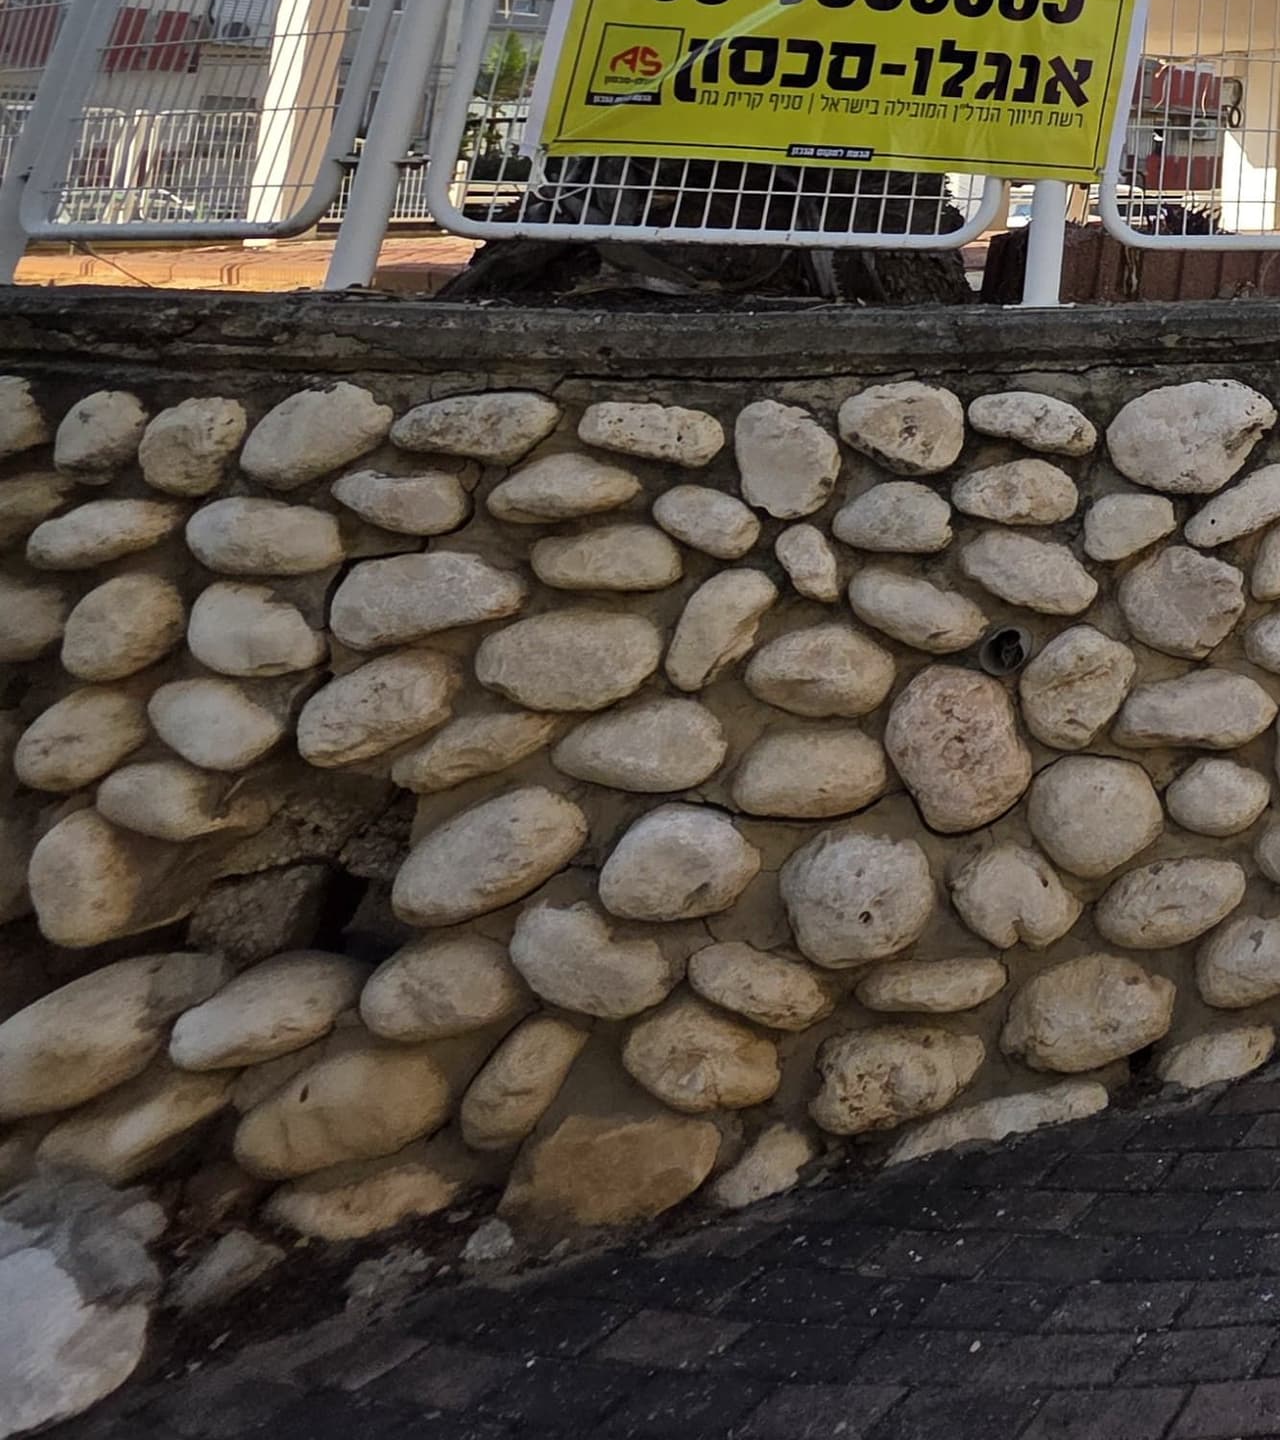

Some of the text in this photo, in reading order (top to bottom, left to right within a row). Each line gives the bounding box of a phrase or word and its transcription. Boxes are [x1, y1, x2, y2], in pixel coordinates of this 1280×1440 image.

[608, 45, 662, 76] AS
[673, 36, 1093, 107] אנגלו-סכסון
[698, 89, 719, 105] גת
[722, 90, 764, 111] קרית
[769, 92, 804, 112] סניף
[820, 93, 880, 116] בישראל
[883, 97, 948, 120] המובילה
[1006, 107, 1044, 127] תיווך
[1047, 110, 1084, 128] רשת
